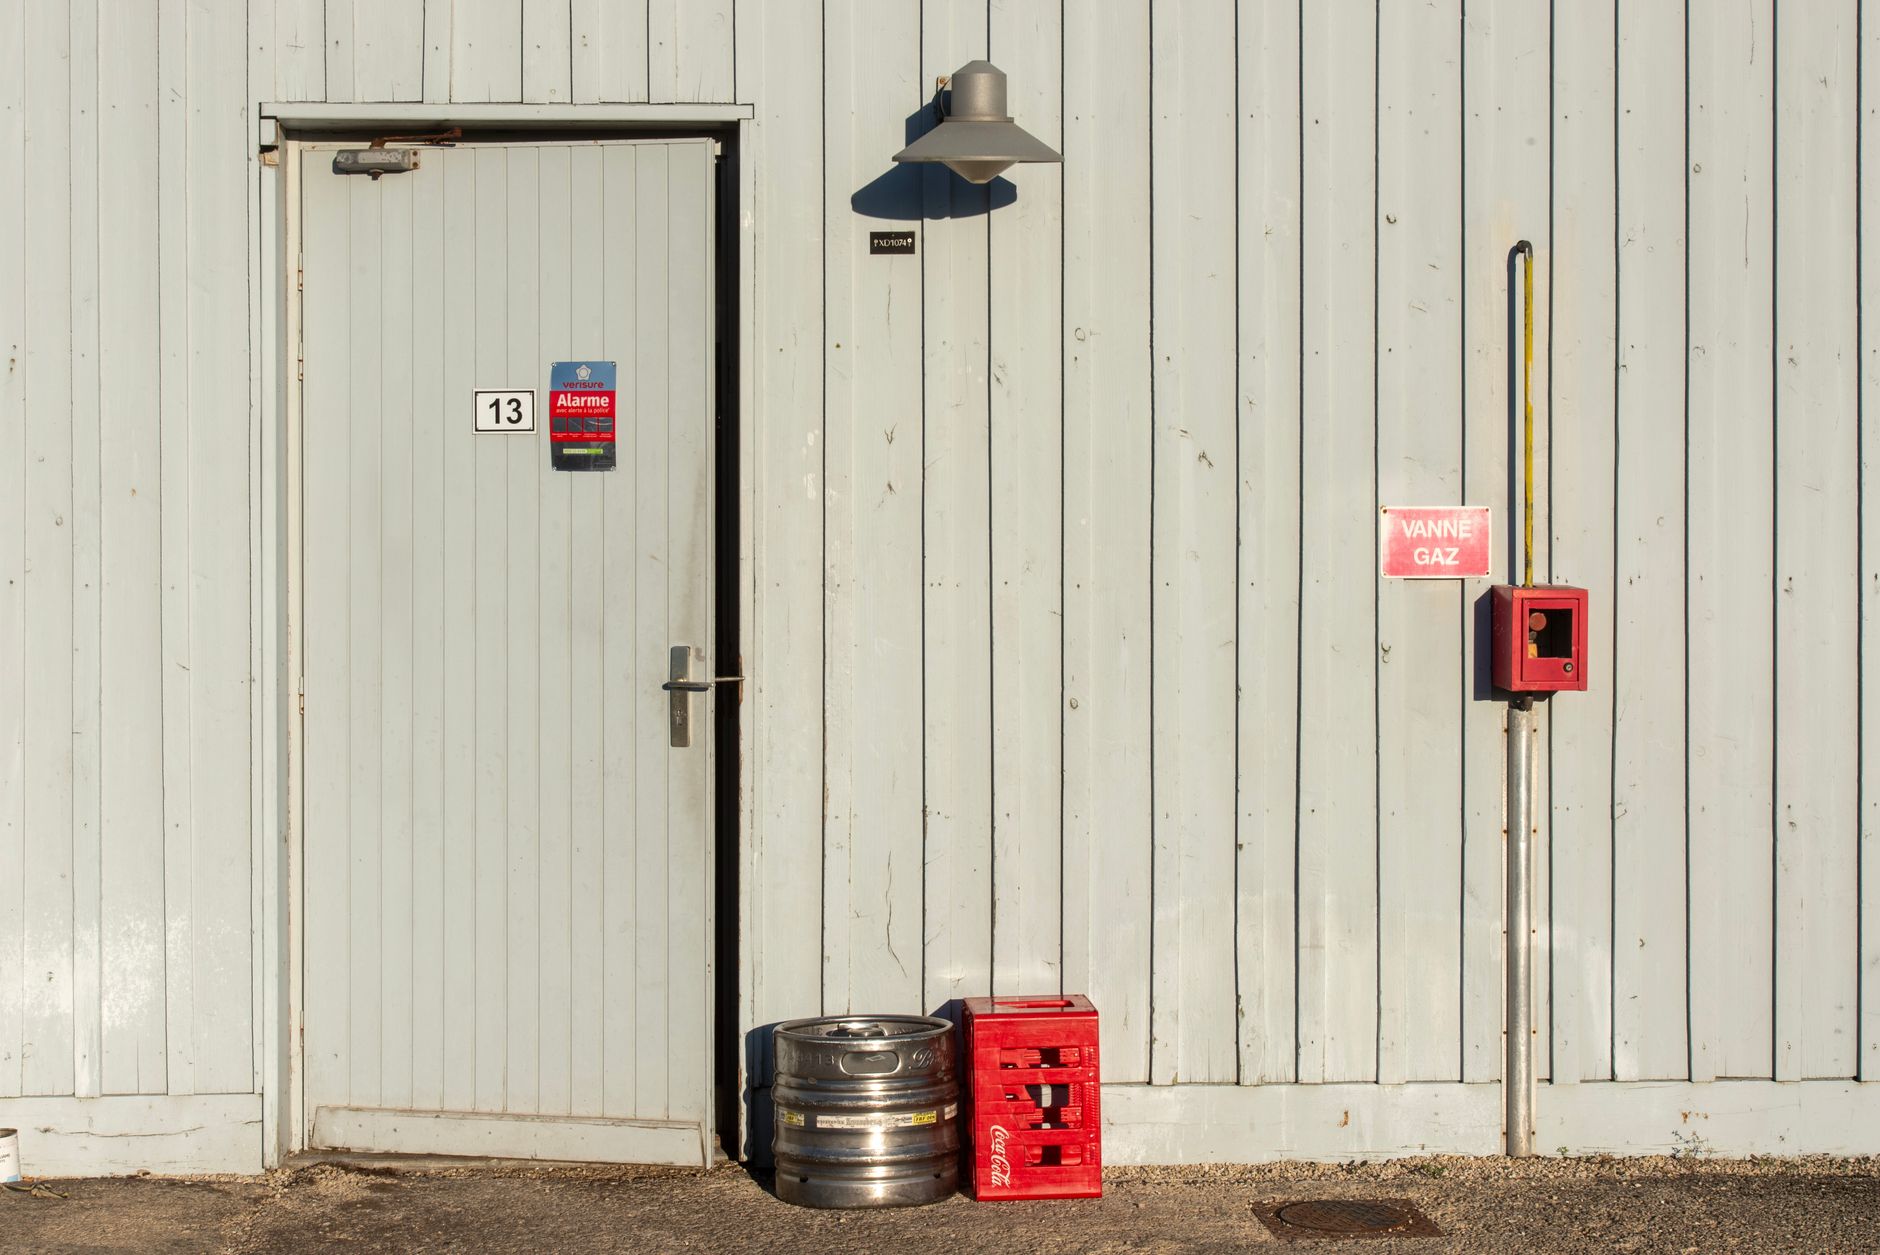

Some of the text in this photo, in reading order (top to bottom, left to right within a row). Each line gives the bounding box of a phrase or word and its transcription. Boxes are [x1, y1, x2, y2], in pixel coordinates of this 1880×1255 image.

[879, 239, 907, 247] XD1074
[562, 381, 604, 389] verisure
[557, 393, 609, 407] Alarme
[489, 398, 522, 424] 13
[1401, 520, 1472, 538] VANNE
[1413, 547, 1460, 566] GAZ
